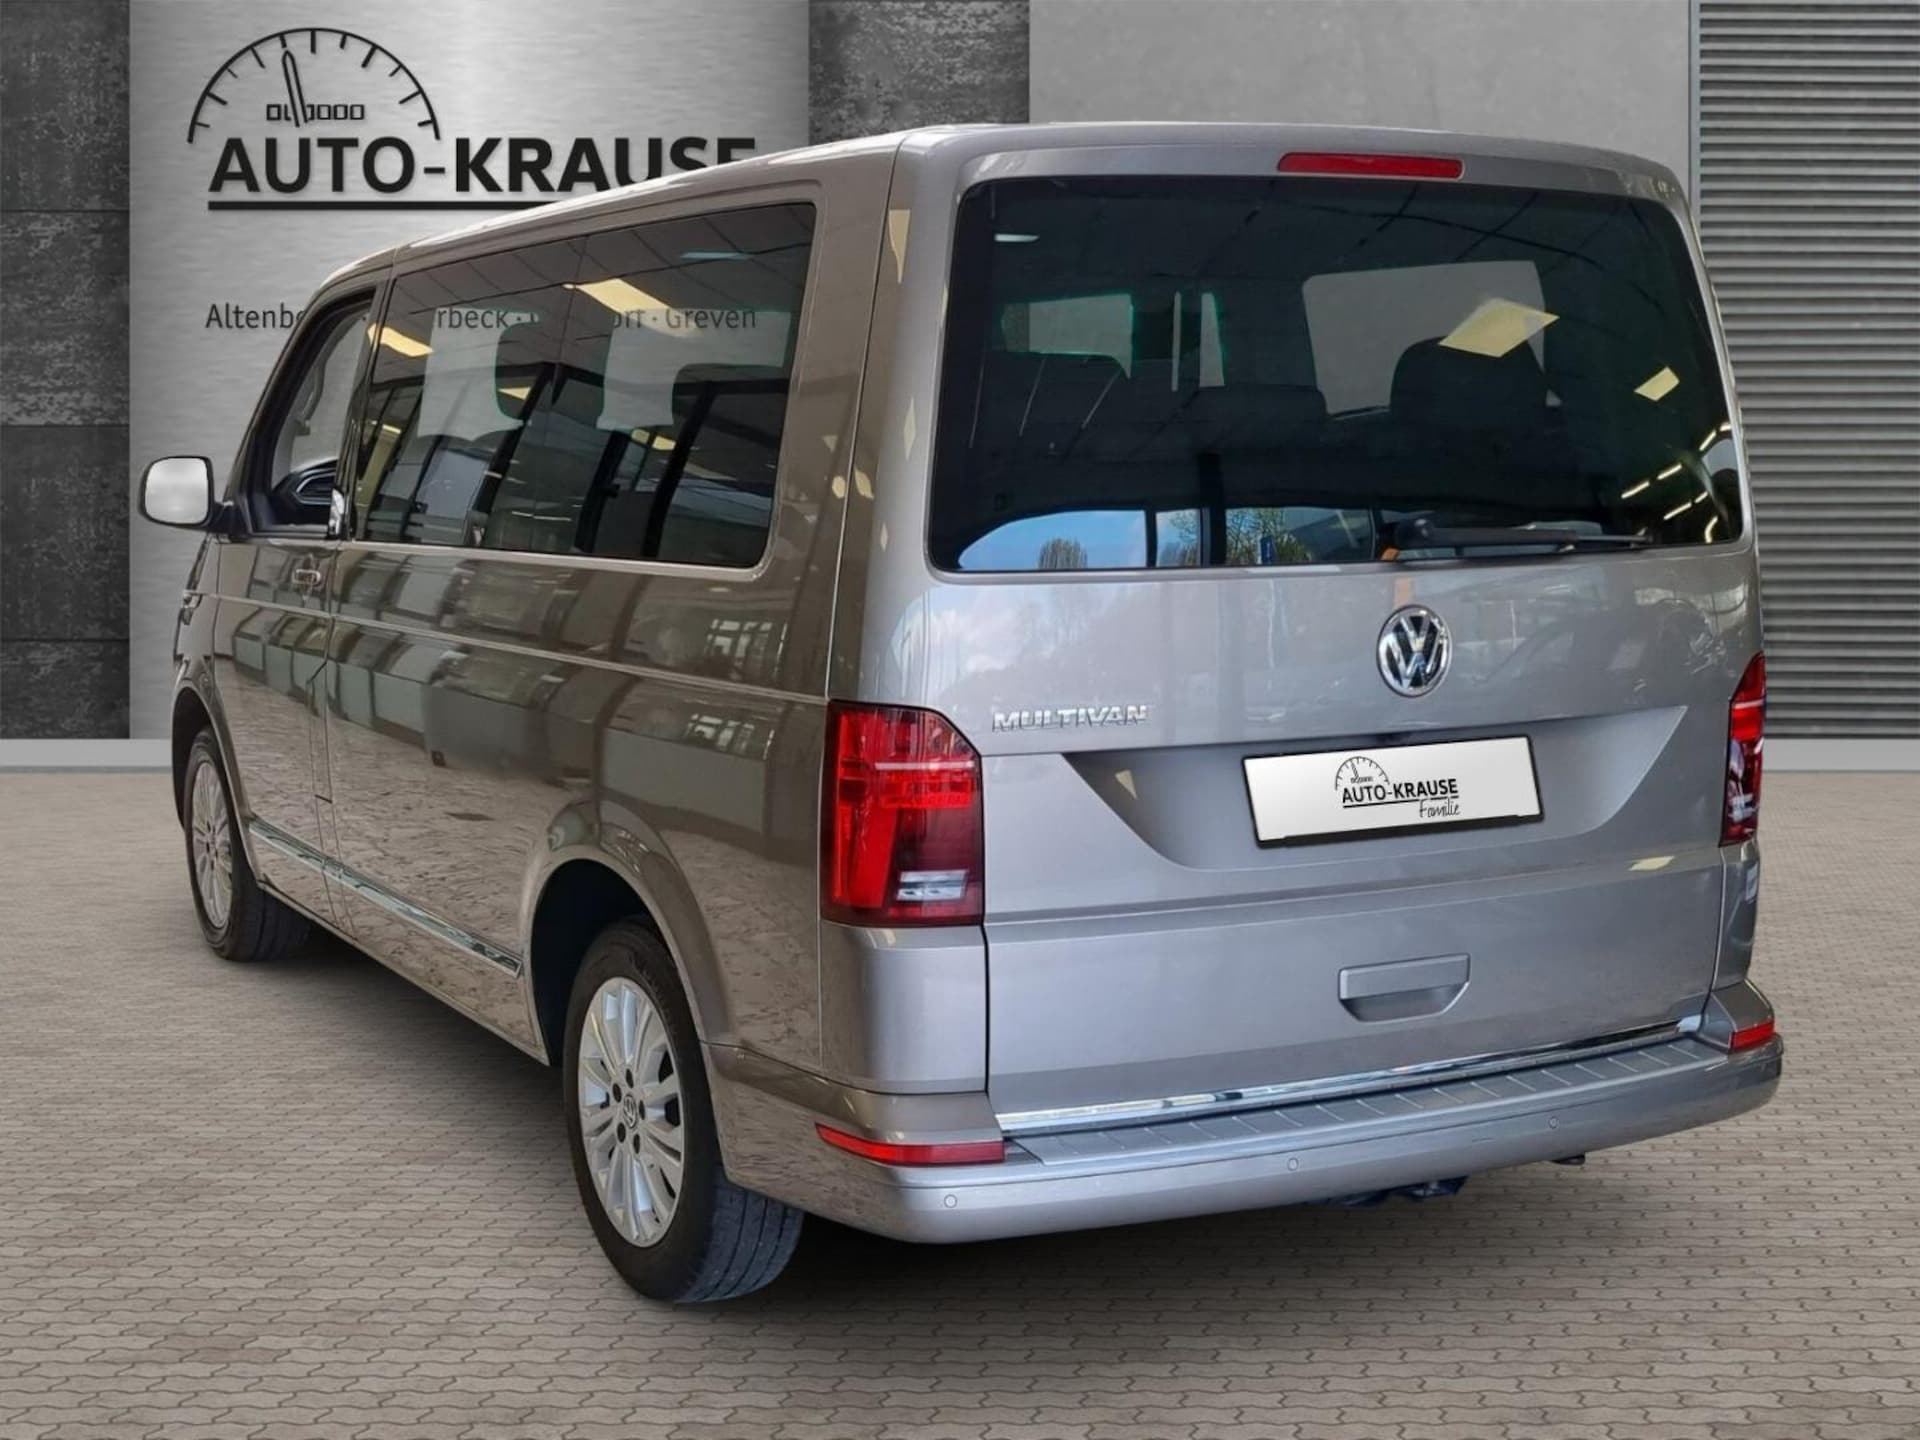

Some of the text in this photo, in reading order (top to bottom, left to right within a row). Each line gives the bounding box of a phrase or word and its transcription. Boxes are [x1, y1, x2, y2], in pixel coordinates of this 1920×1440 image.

[665, 306, 756, 329] Greven
[992, 705, 1147, 732] MULTIVAN
[1342, 779, 1458, 803] AUTO-KRAUSE
[1419, 797, 1461, 818] Familie
